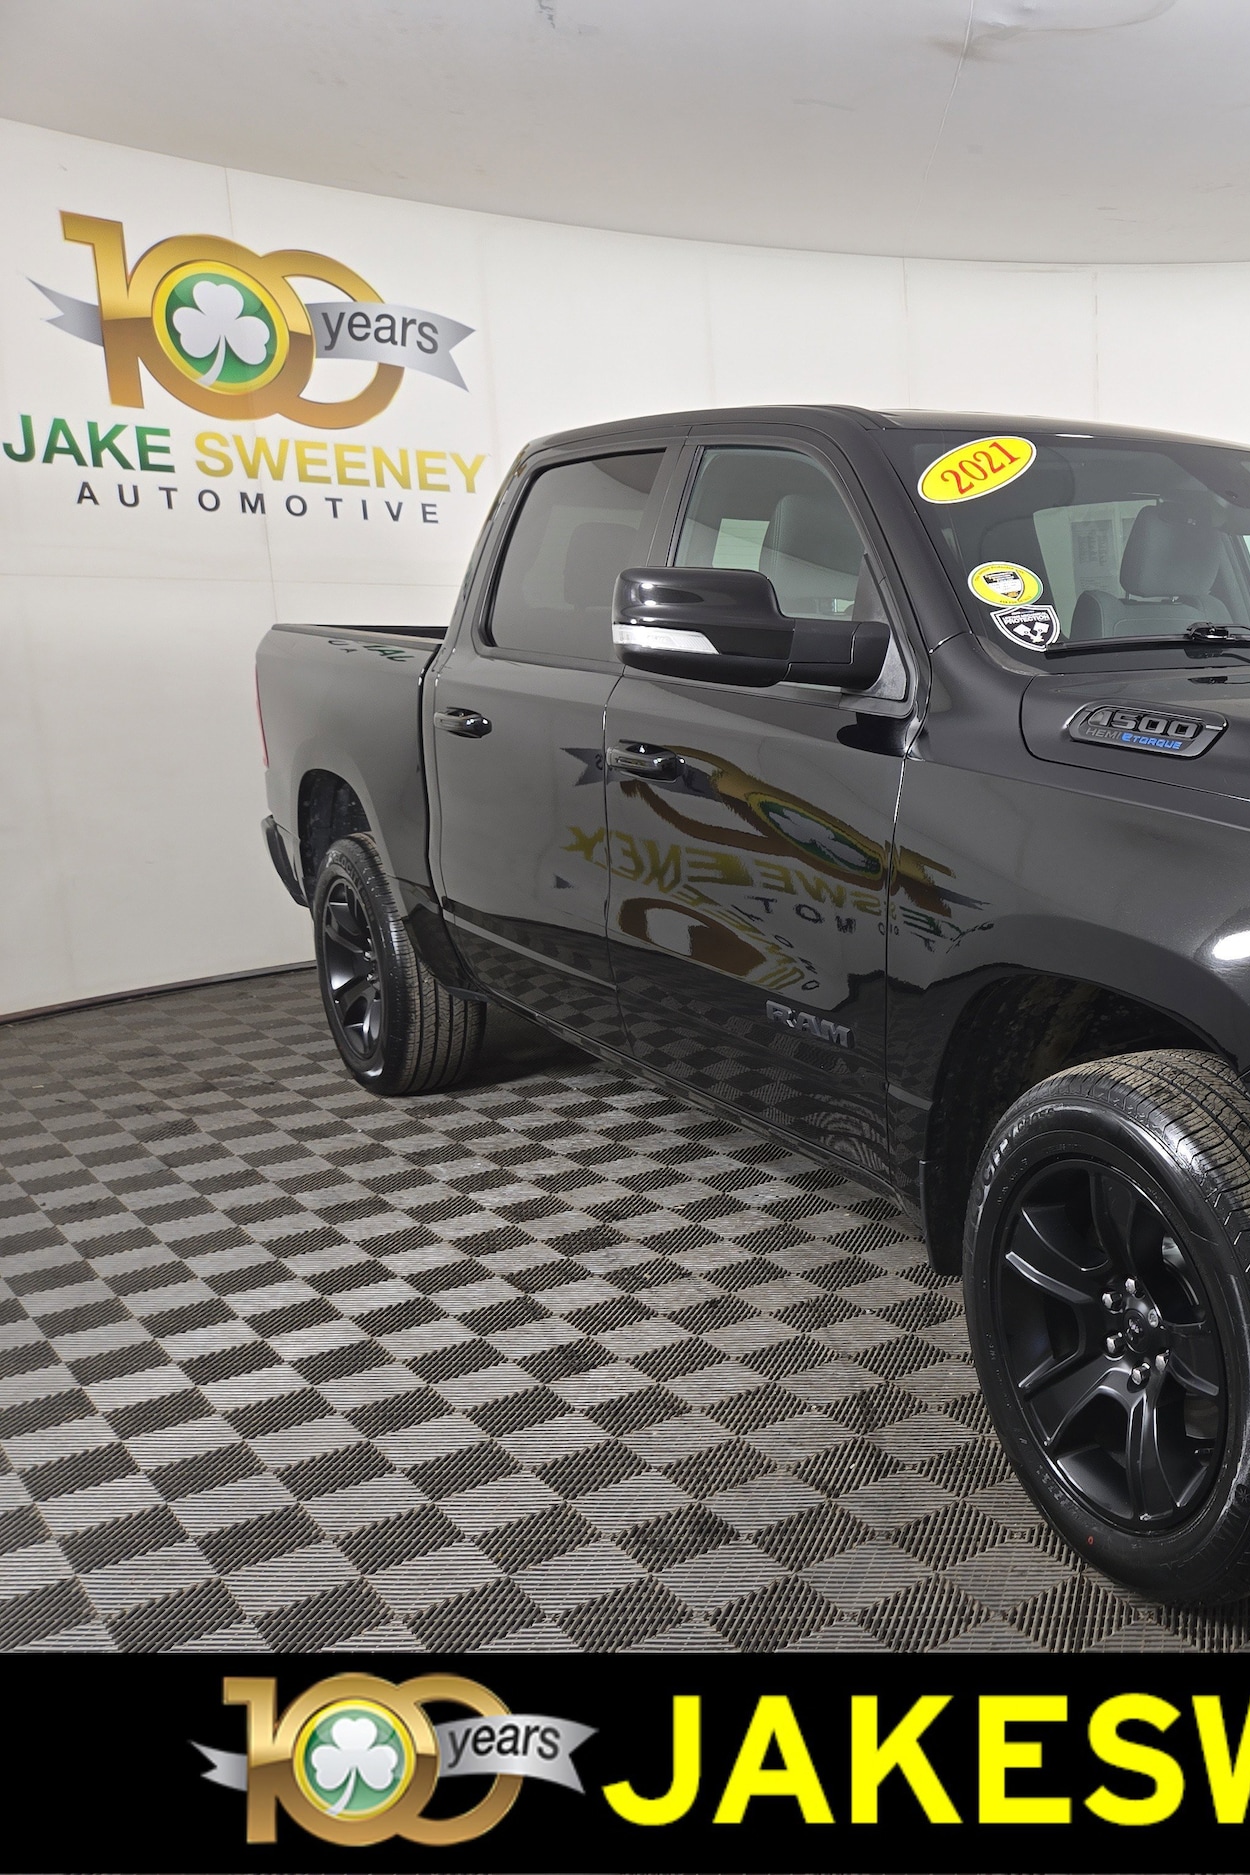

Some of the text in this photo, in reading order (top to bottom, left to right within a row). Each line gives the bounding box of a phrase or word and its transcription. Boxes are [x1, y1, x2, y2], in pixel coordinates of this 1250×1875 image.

[321, 309, 440, 355] years
[2, 414, 486, 494] JAKE SWEENEY
[940, 441, 1021, 495] 2021
[76, 480, 440, 524] AUTOMOTIVE
[1085, 727, 1121, 740] HEMI
[1087, 709, 1199, 738] 1500
[765, 1000, 853, 1048] RAM
